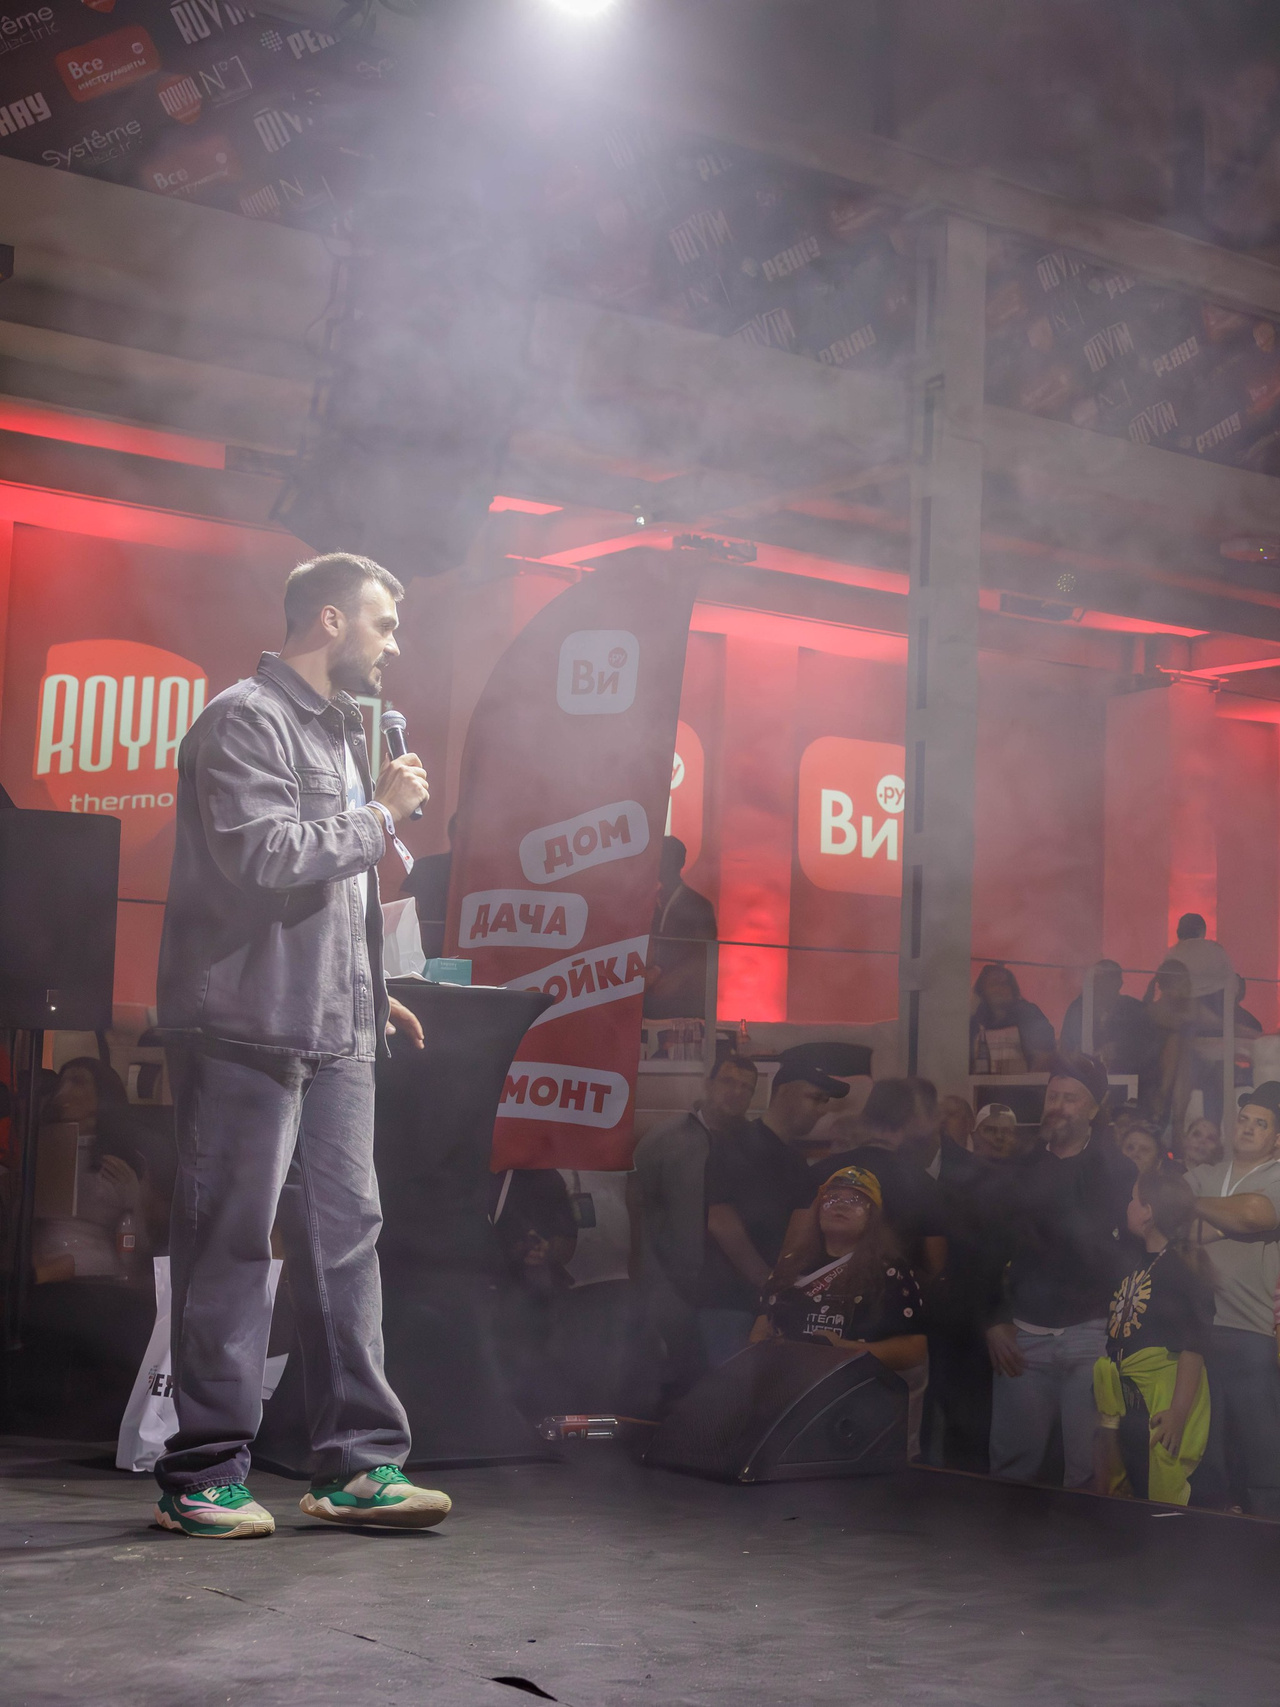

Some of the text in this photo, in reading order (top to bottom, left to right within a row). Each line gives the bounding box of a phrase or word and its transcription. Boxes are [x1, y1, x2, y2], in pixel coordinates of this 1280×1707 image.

[67, 57, 103, 80] Все
[571, 659, 620, 696] Ви
[70, 792, 174, 812] thermo
[820, 788, 898, 861] Ви
[543, 814, 632, 875] ДОМ
[469, 902, 568, 940] ДАЧА
[524, 950, 647, 1004] ОЙКА
